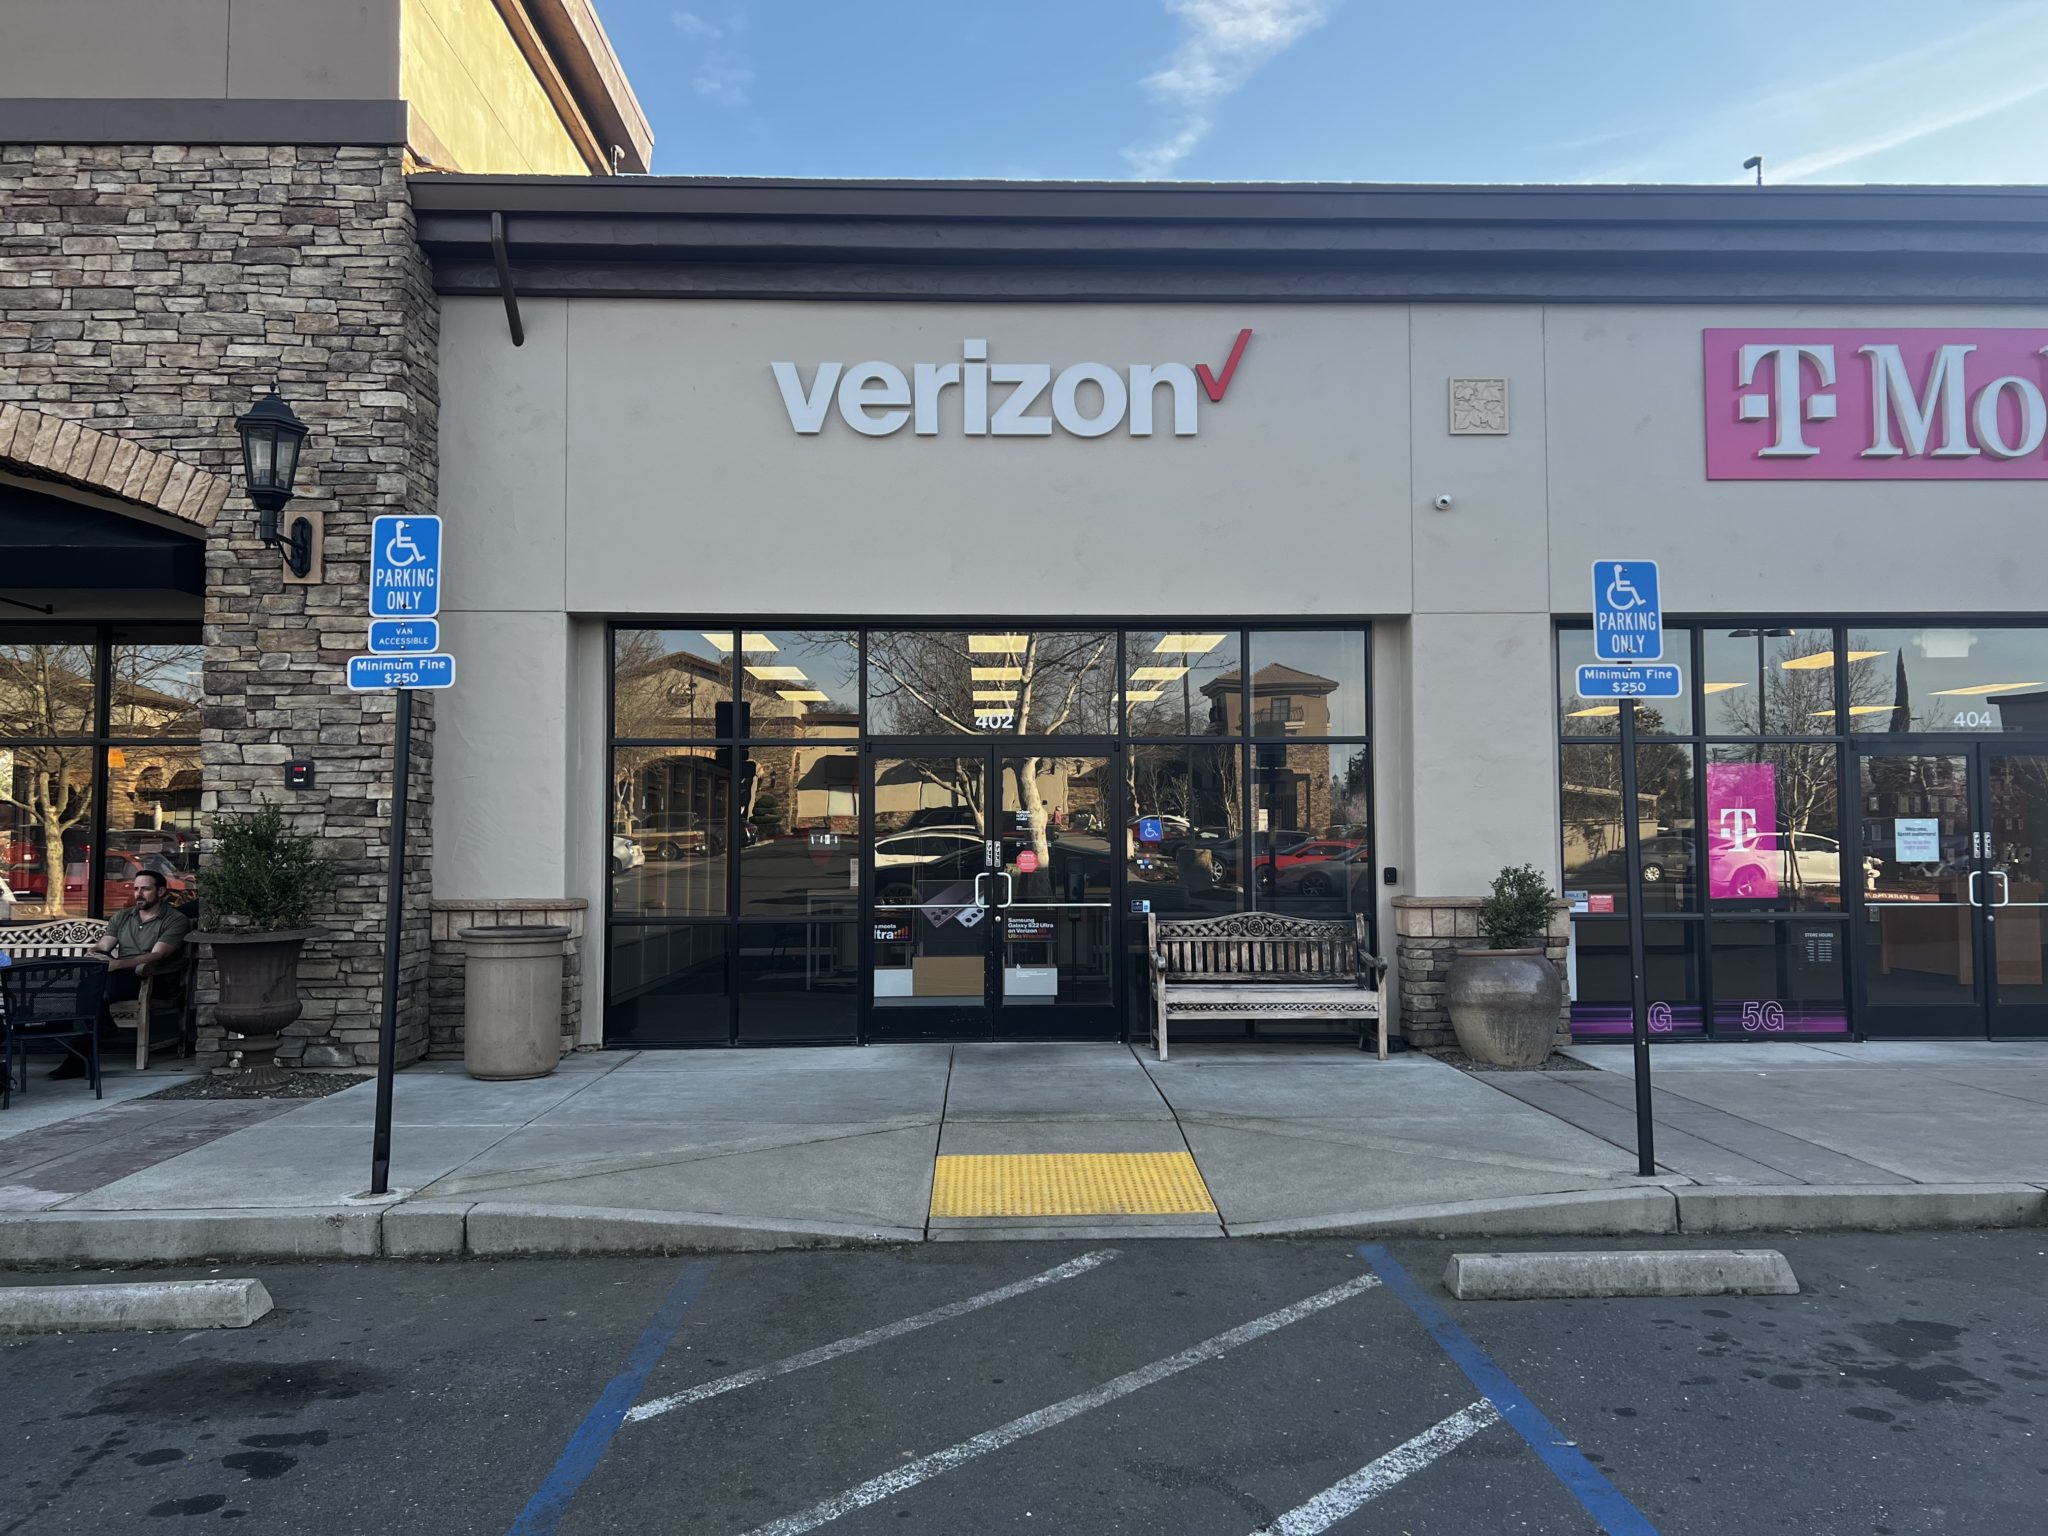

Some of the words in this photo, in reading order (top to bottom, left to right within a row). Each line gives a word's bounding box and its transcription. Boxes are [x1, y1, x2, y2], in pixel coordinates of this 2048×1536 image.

[770, 338, 1198, 437] verizon
[1857, 344, 2048, 460] Mo
[376, 568, 434, 587] PARKING
[387, 591, 422, 610] ONLY
[1600, 612, 1656, 631] PARKING
[379, 637, 429, 645] ACCESSIBLE
[1611, 634, 1645, 653] ONLY
[356, 659, 413, 671] Minimum
[419, 659, 446, 670] Fine
[1584, 669, 1640, 679] Minimum
[1646, 669, 1672, 679] Fine
[384, 672, 419, 684] $250
[1612, 682, 1646, 692] $250
[975, 714, 1014, 729] 402
[1953, 711, 1992, 727] 404
[1720, 808, 1756, 852] T
[1630, 1001, 1673, 1031] G
[1742, 1000, 1784, 1031] 5G
